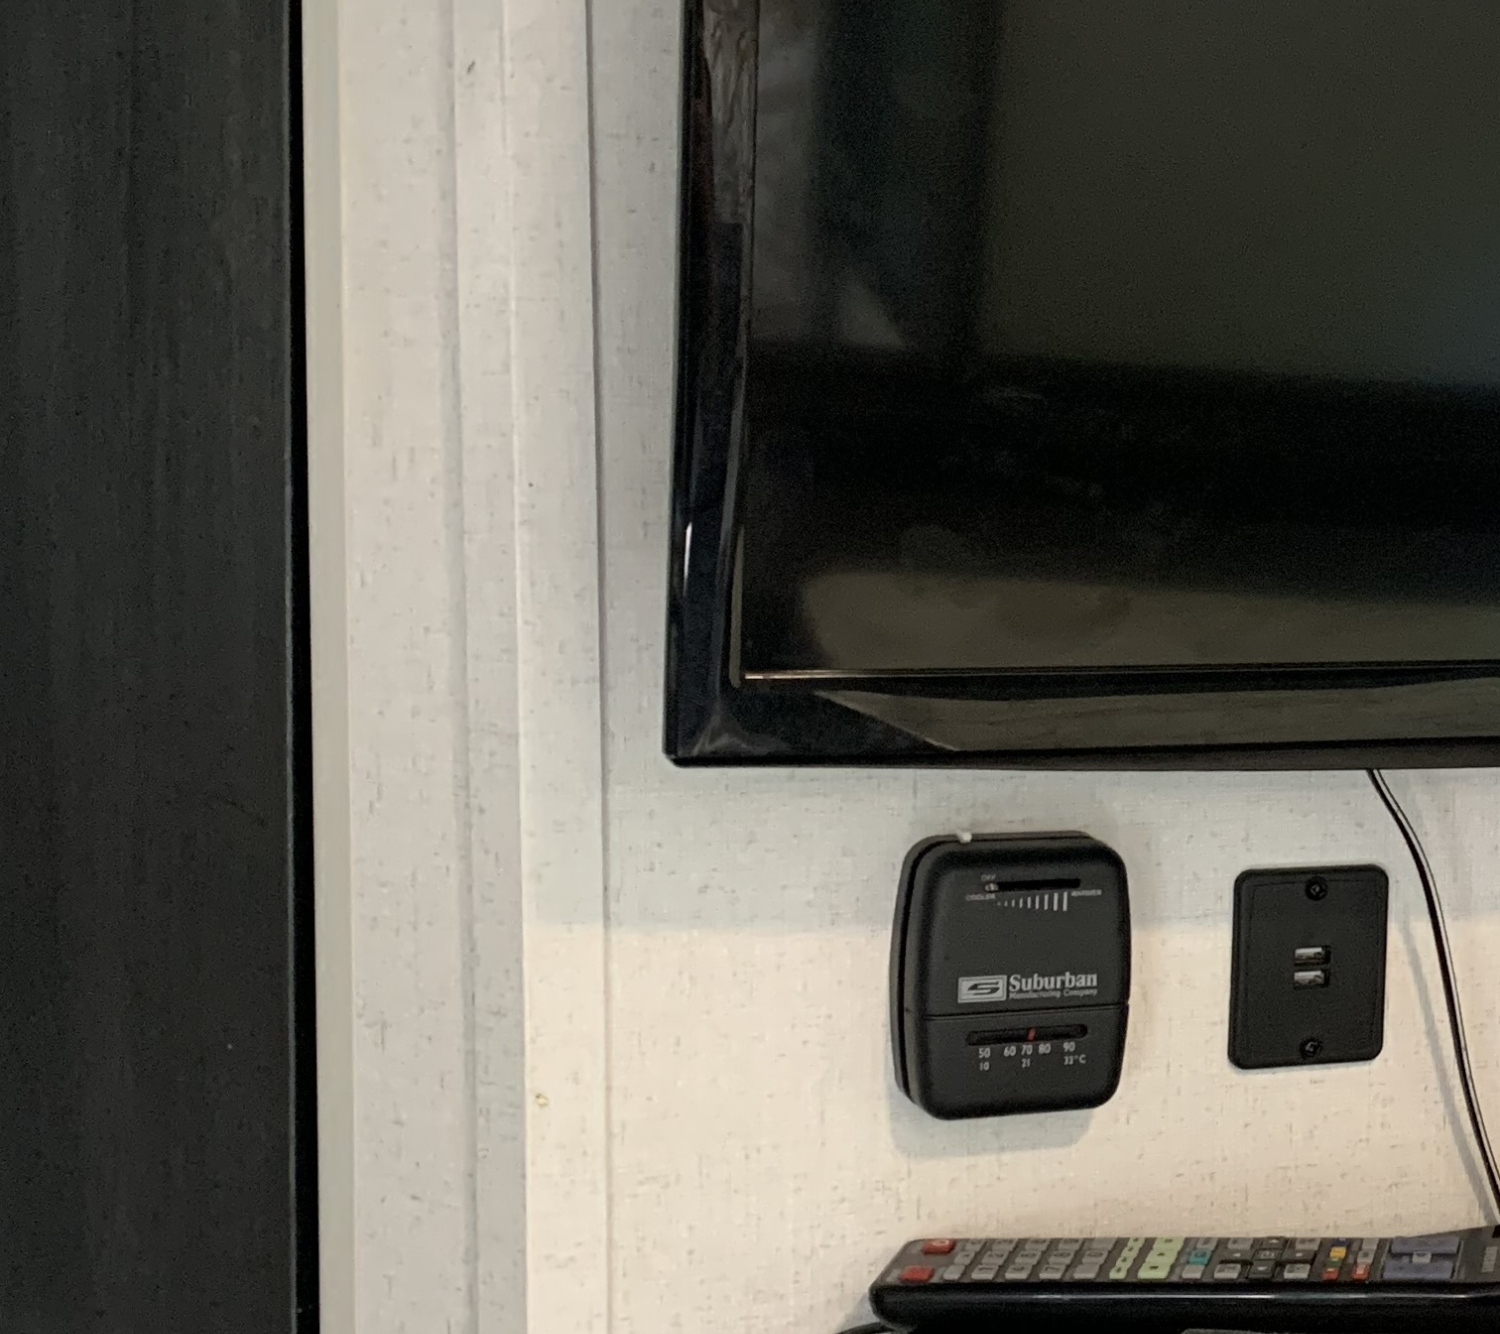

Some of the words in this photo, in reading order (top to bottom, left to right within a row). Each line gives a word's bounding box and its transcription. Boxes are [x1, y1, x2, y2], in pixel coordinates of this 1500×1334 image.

[1009, 971, 1098, 992] Suburban
[979, 1047, 991, 1059] 50
[1003, 1045, 1017, 1057] 60
[1021, 1044, 1033, 1056] 70
[1038, 1042, 1052, 1055] 80
[1063, 1041, 1076, 1053] 90
[979, 1061, 990, 1071] 10
[1021, 1058, 1031, 1068] 21
